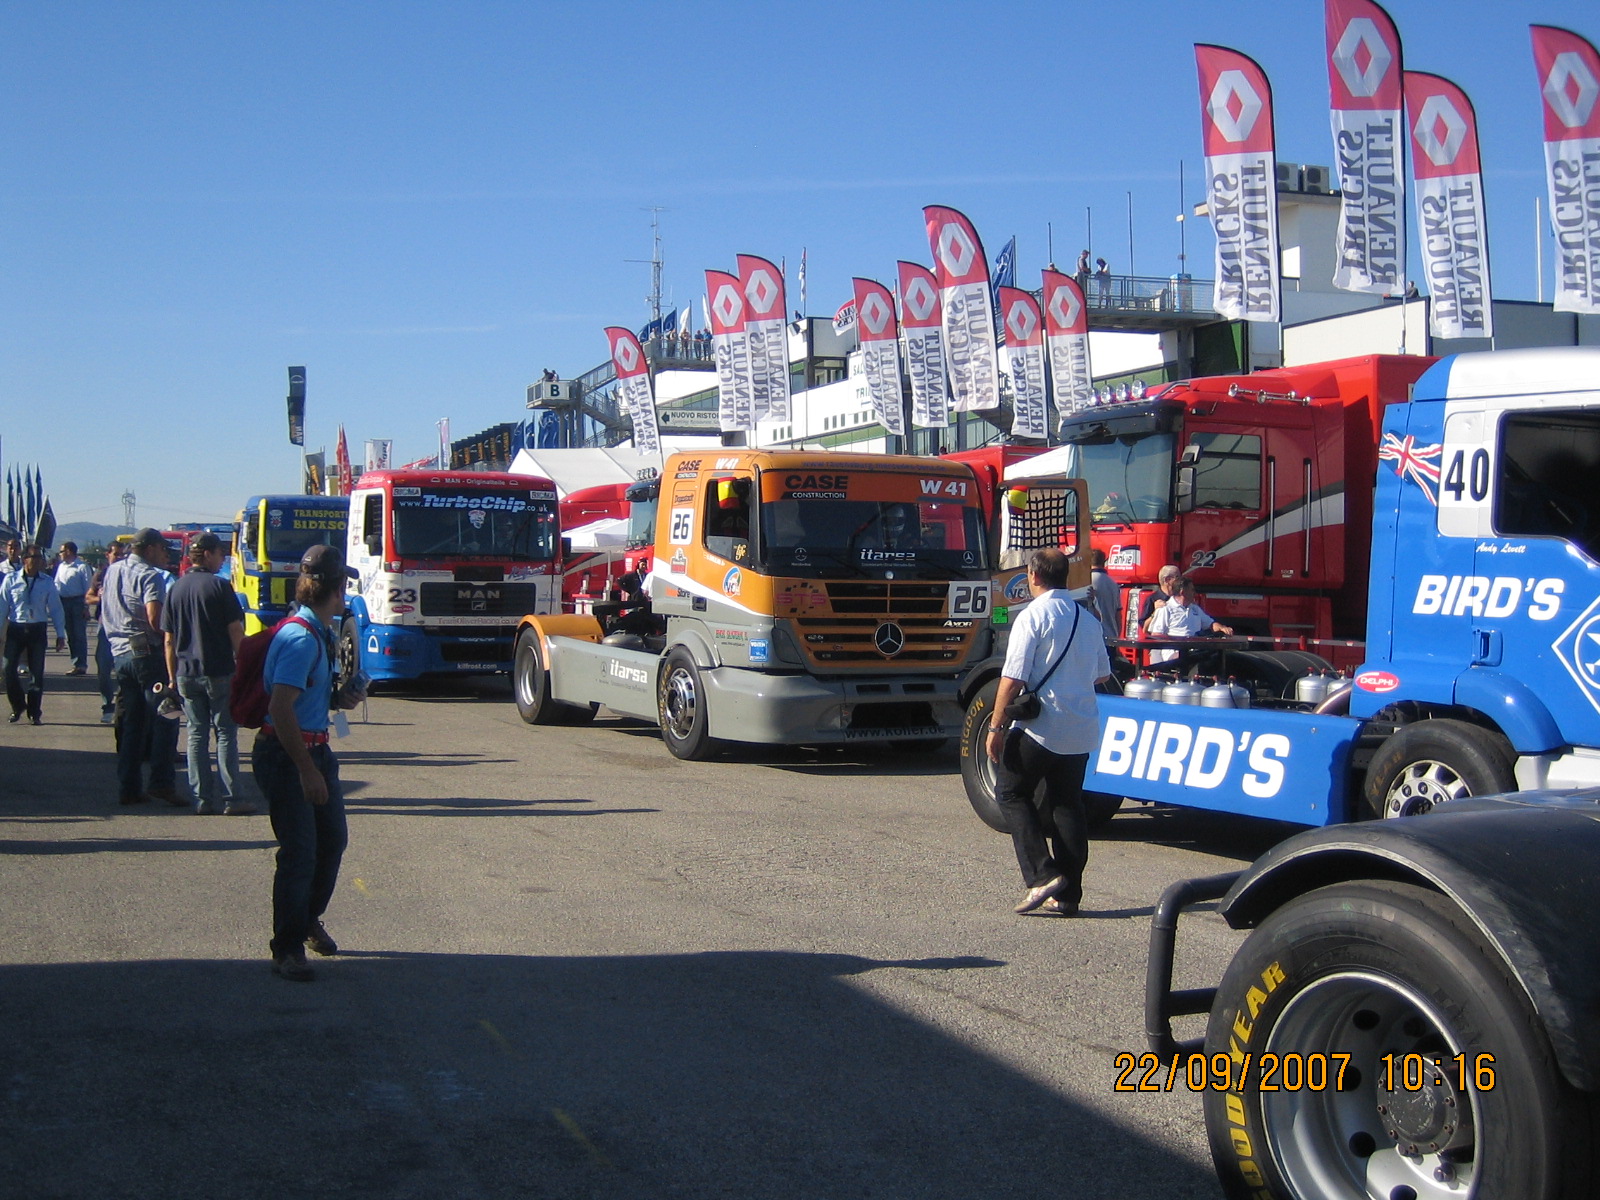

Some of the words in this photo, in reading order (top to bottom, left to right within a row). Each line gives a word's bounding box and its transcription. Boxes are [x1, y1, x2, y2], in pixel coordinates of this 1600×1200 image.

[550, 384, 560, 397] B
[671, 411, 695, 419] NUOVO
[677, 460, 702, 471] CASE
[1444, 447, 1489, 501] 40
[784, 475, 849, 490] CASE
[920, 479, 943, 494] W
[945, 481, 967, 496] 41
[792, 491, 846, 499] CONSTRUCTION
[672, 513, 690, 540] 26
[1476, 541, 1498, 555] Andy
[1190, 551, 1218, 567] 22
[388, 588, 417, 603] 23
[457, 590, 500, 599] MAN
[953, 586, 988, 613] 26
[1412, 574, 1565, 621] BIRD'S
[610, 659, 648, 684] itarsa
[1360, 677, 1394, 687] DELPHI
[961, 697, 985, 758] RIGDON
[1096, 716, 1290, 798] BIRD'S
